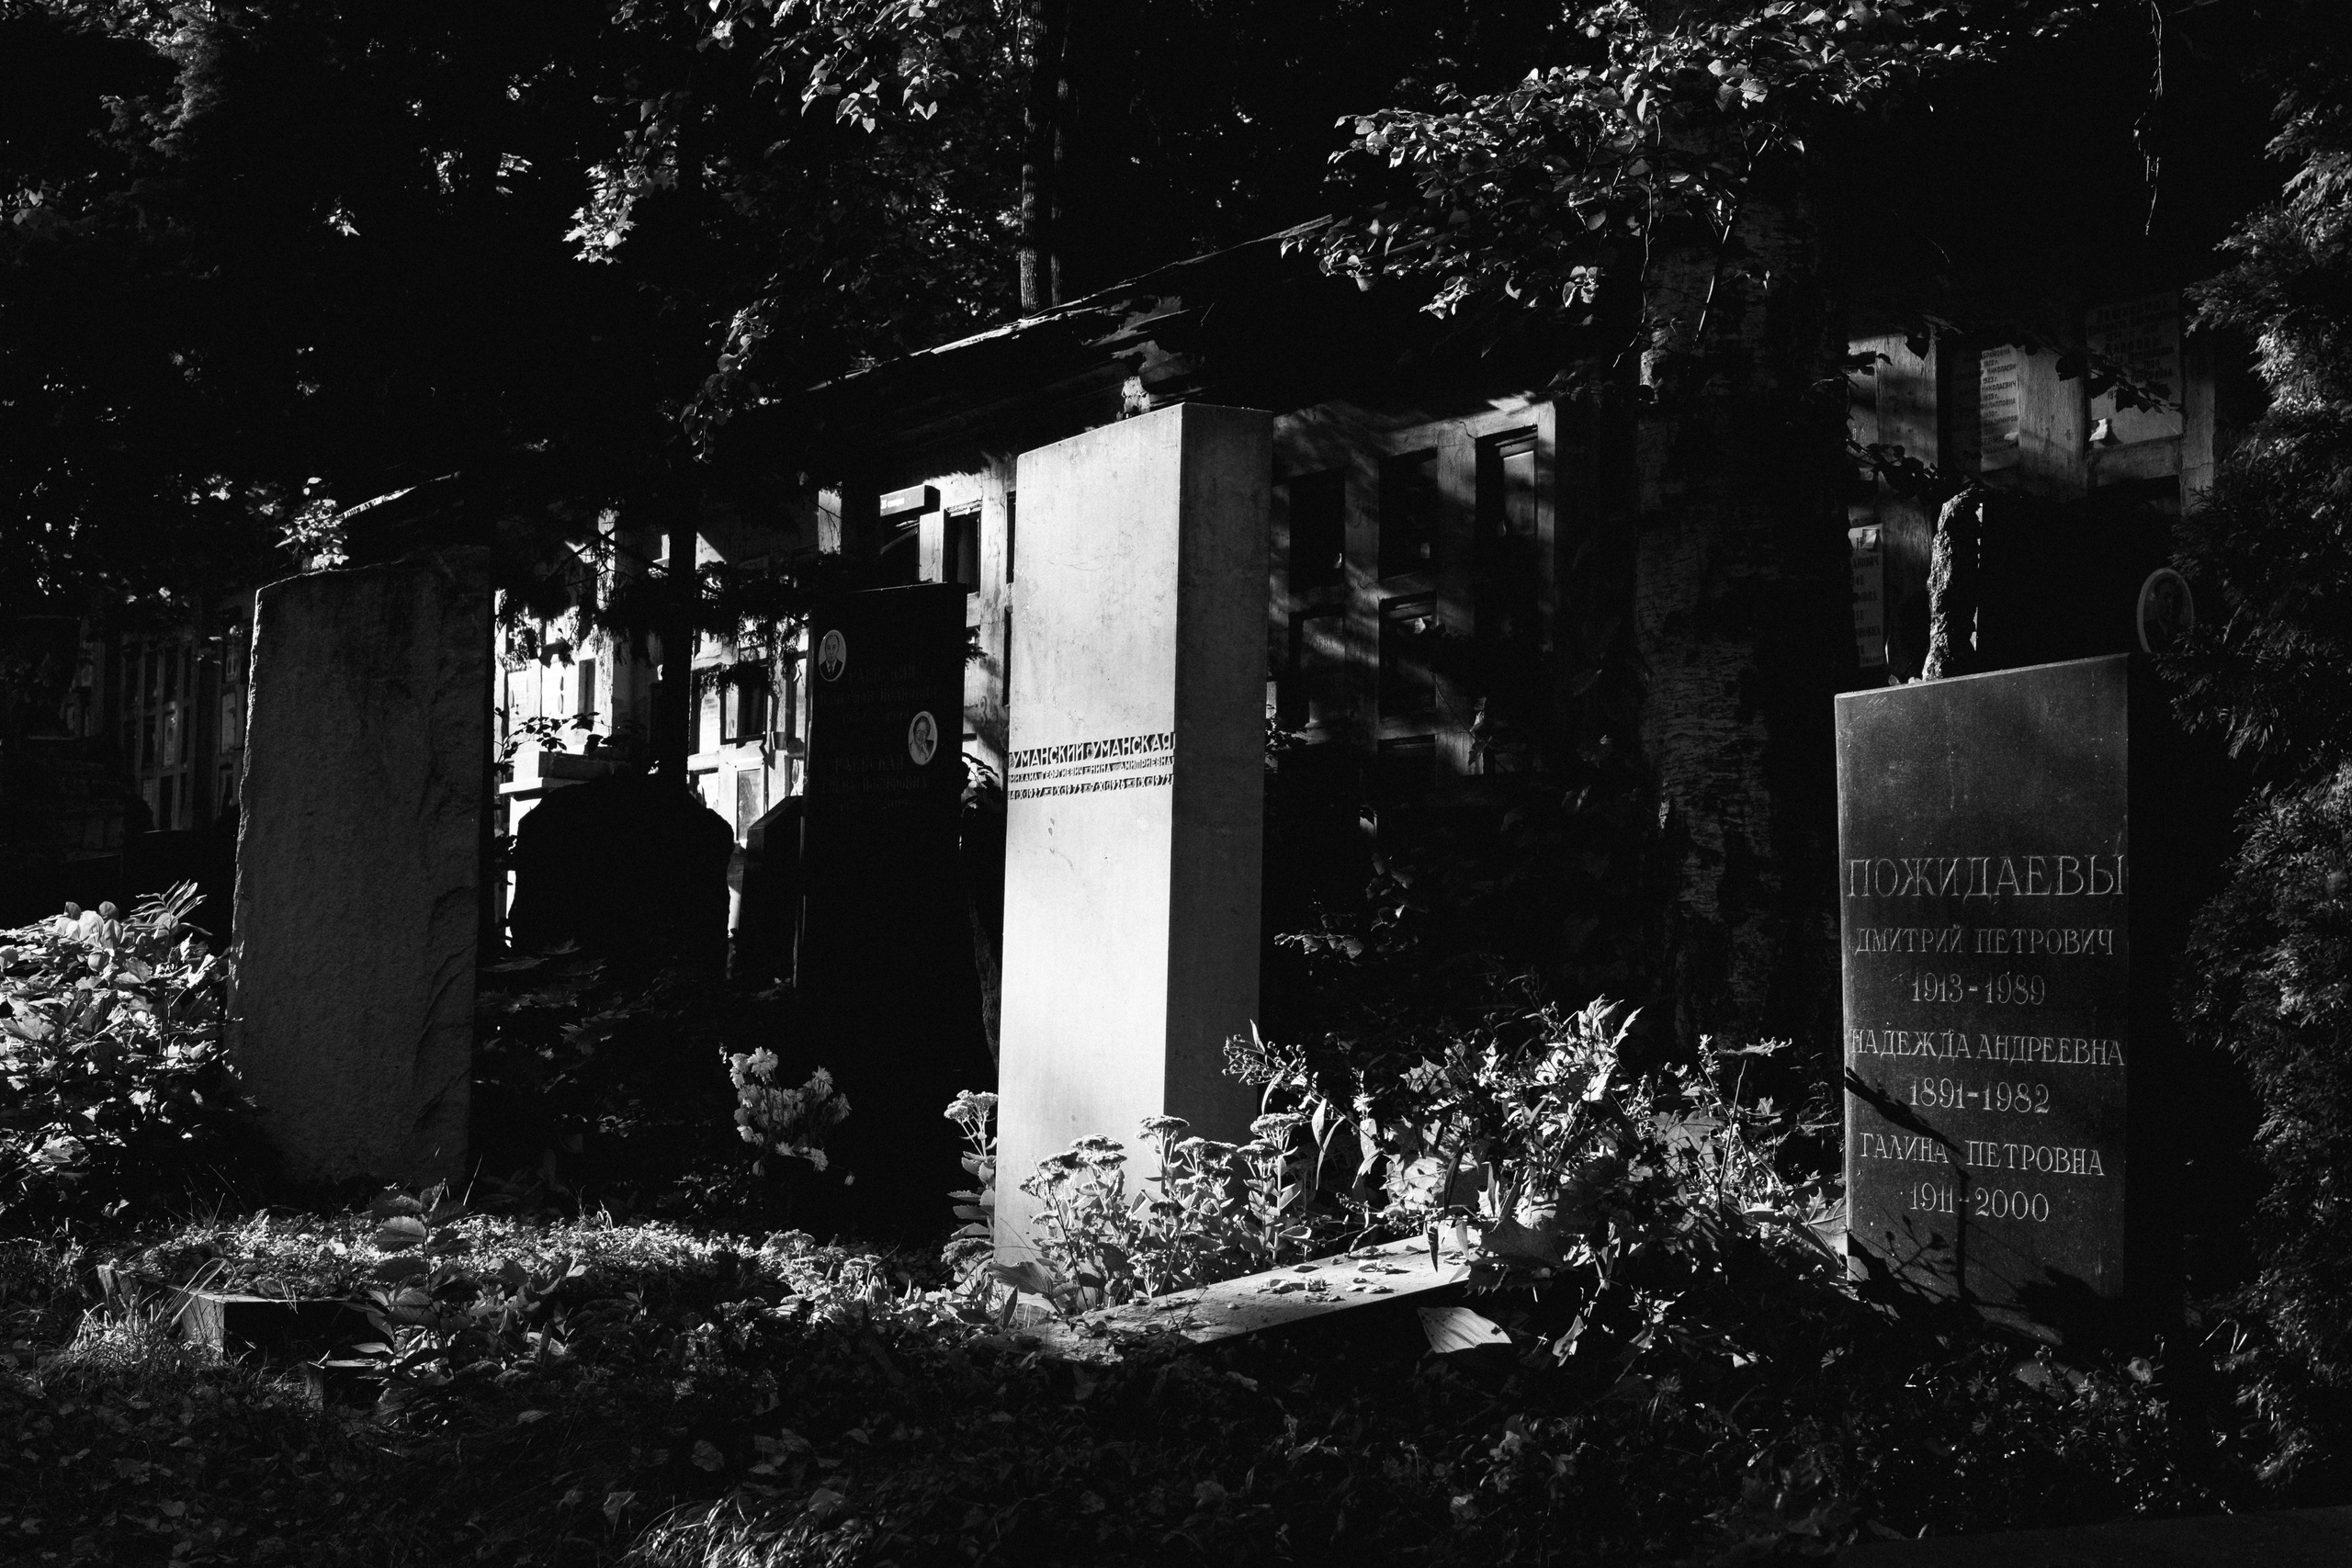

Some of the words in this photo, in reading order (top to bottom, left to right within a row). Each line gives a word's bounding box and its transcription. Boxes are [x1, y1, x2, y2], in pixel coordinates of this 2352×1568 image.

[1012, 742, 1084, 770] УМАНСКИЙ
[1091, 732, 1174, 760] УМАНСКАЯ
[1847, 854, 2125, 901] ПОЖИДАЕВЫ
[1854, 924, 1962, 955] ДМИТРИЙ
[1974, 928, 2115, 956] ПЕТРОВИЧ
[1850, 1028, 1970, 1062] НАДЕЖДА
[1976, 1033, 2125, 1066] АНДРЕЕВНА
[1859, 1132, 1950, 1164] ГАЛИНА
[1964, 1139, 2106, 1177] ПЕТРОВНА
